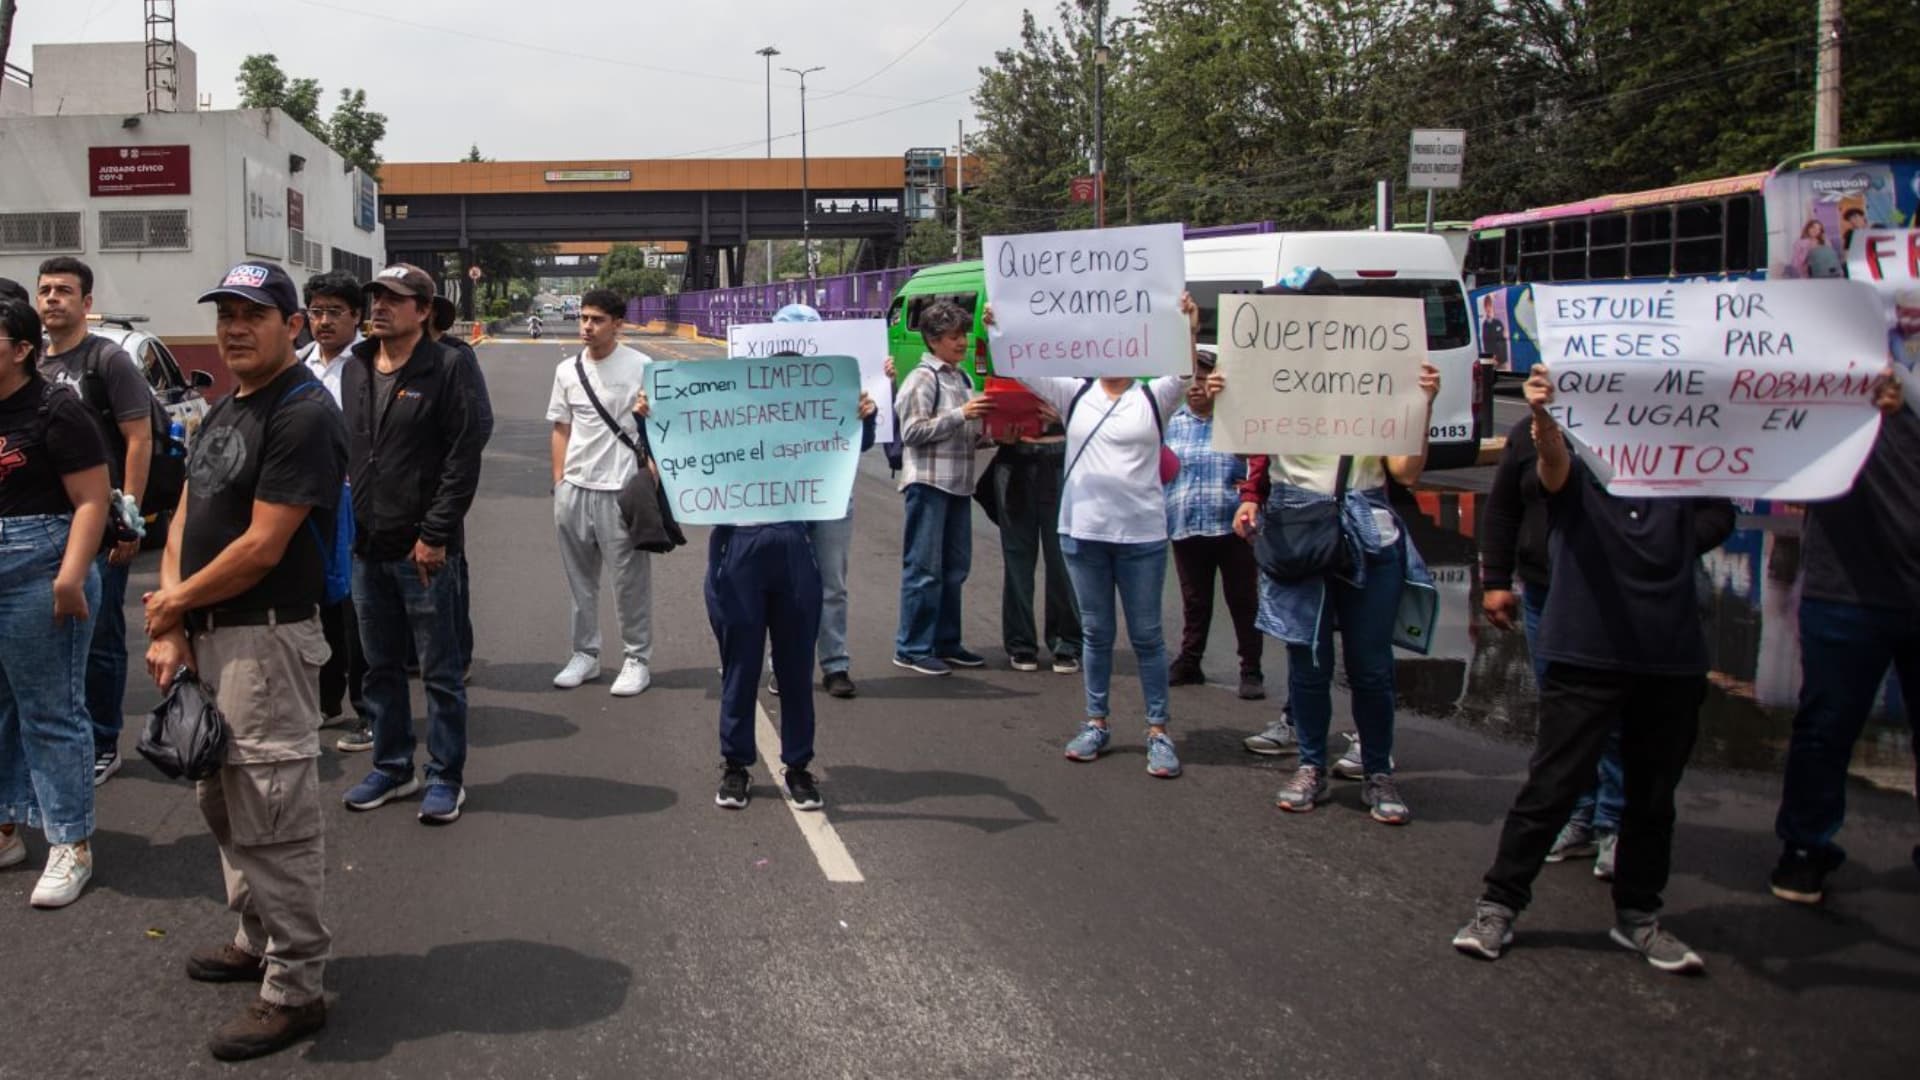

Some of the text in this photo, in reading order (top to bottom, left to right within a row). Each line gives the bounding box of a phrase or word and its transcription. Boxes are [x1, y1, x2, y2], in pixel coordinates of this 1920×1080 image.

[999, 241, 1149, 278] Queremos
[1030, 289, 1151, 315] examen
[1557, 290, 1772, 321] ESTUDIÉ POR
[1231, 302, 1411, 350] Queremos
[1563, 329, 1794, 357] MESES PARA
[1009, 324, 1149, 368] presencial
[653, 363, 834, 401] Examen LIMPIO
[1272, 368, 1393, 395] examen
[1558, 362, 1879, 400] QUE ME ROBARÁN
[680, 398, 846, 433] TRANSPARENTE,
[1243, 404, 1410, 444] presencial
[1430, 425, 1466, 438] 0183
[1604, 402, 1720, 429] LUGAR
[1762, 408, 1807, 431] EN
[661, 431, 850, 480] que gane el aspirante
[679, 478, 828, 513] CONSCIENTE
